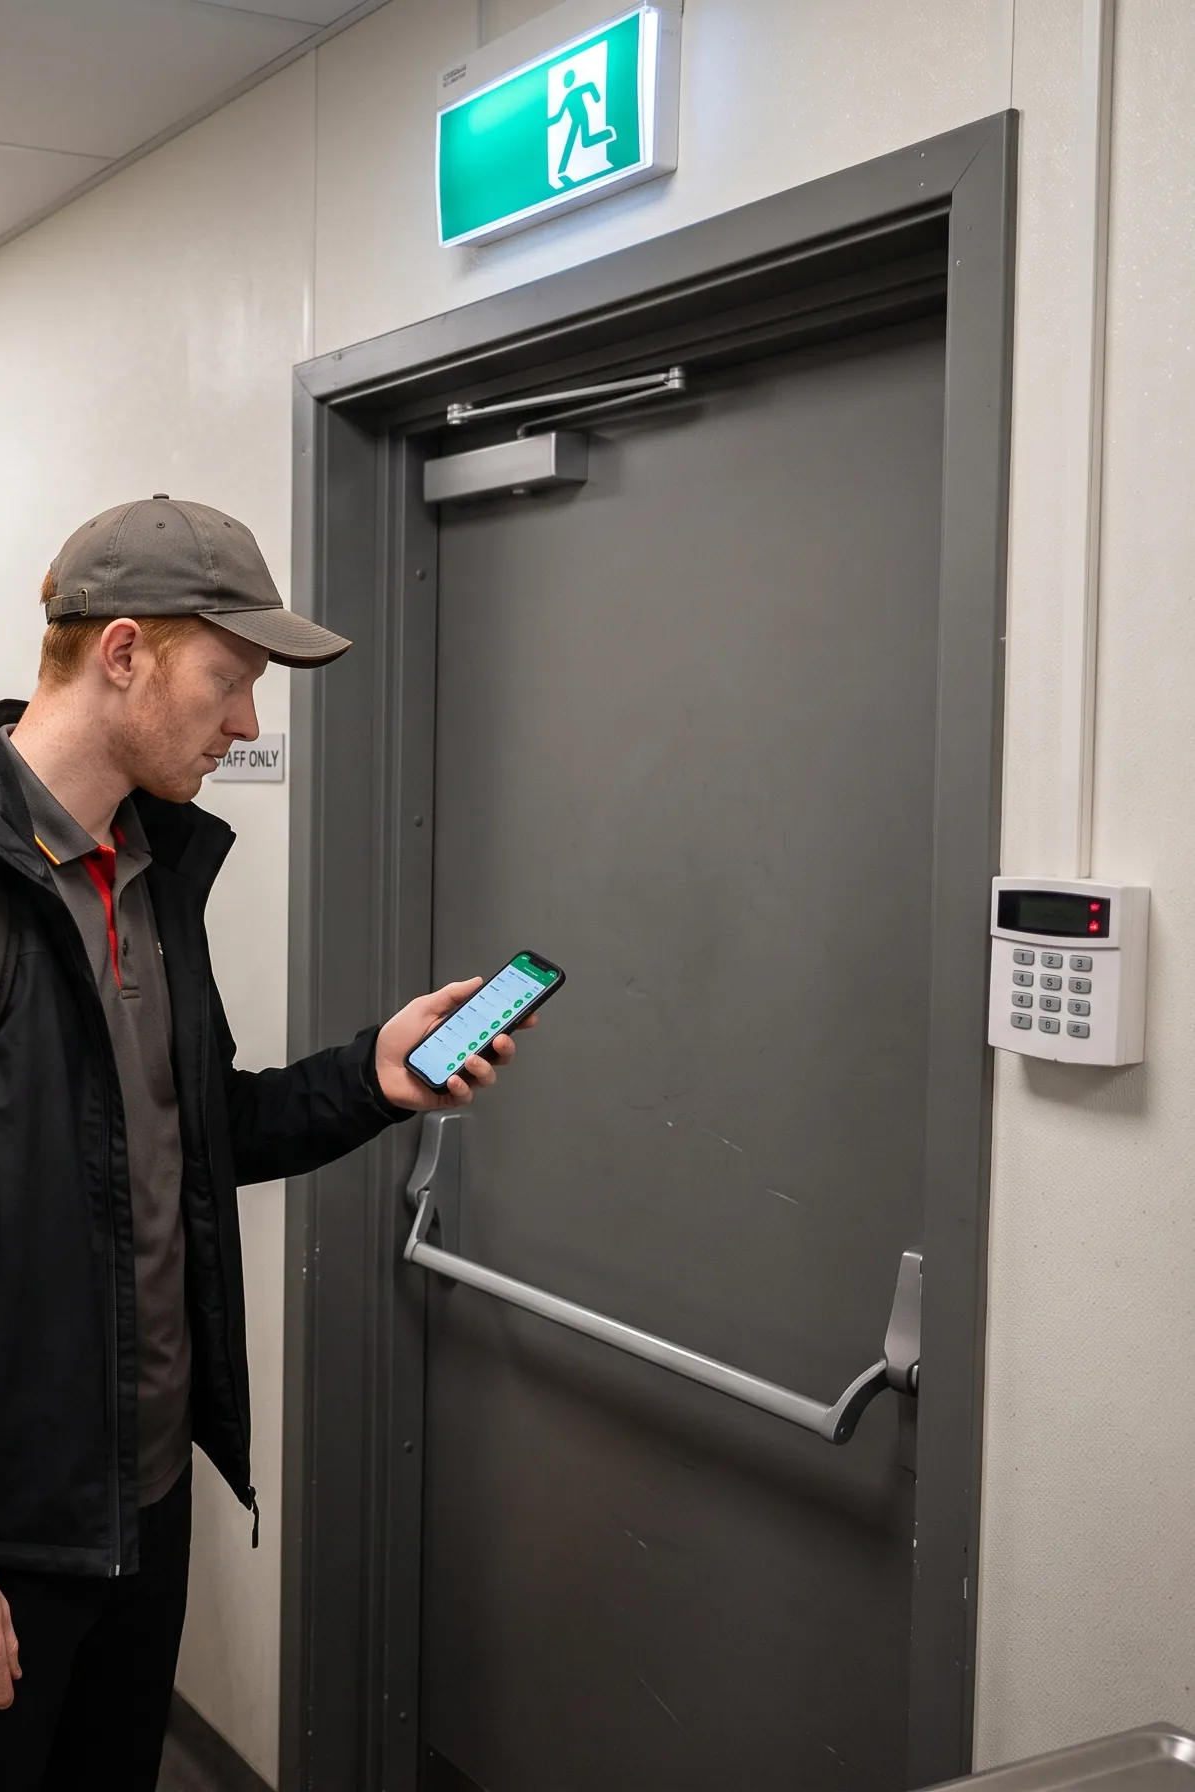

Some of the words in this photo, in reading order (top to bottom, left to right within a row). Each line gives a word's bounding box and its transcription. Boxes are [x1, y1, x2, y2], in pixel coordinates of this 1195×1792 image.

[249, 750, 279, 767] ONLY
[1021, 953, 1025, 961] 1
[1047, 956, 1054, 965] 2
[1076, 959, 1083, 968] 3
[1019, 974, 1024, 983] 4
[1046, 978, 1053, 987] 5
[1018, 995, 1024, 1004] 4
[1046, 999, 1052, 1008] 8
[1075, 1003, 1081, 1012] 9
[1017, 1016, 1023, 1025] 7
